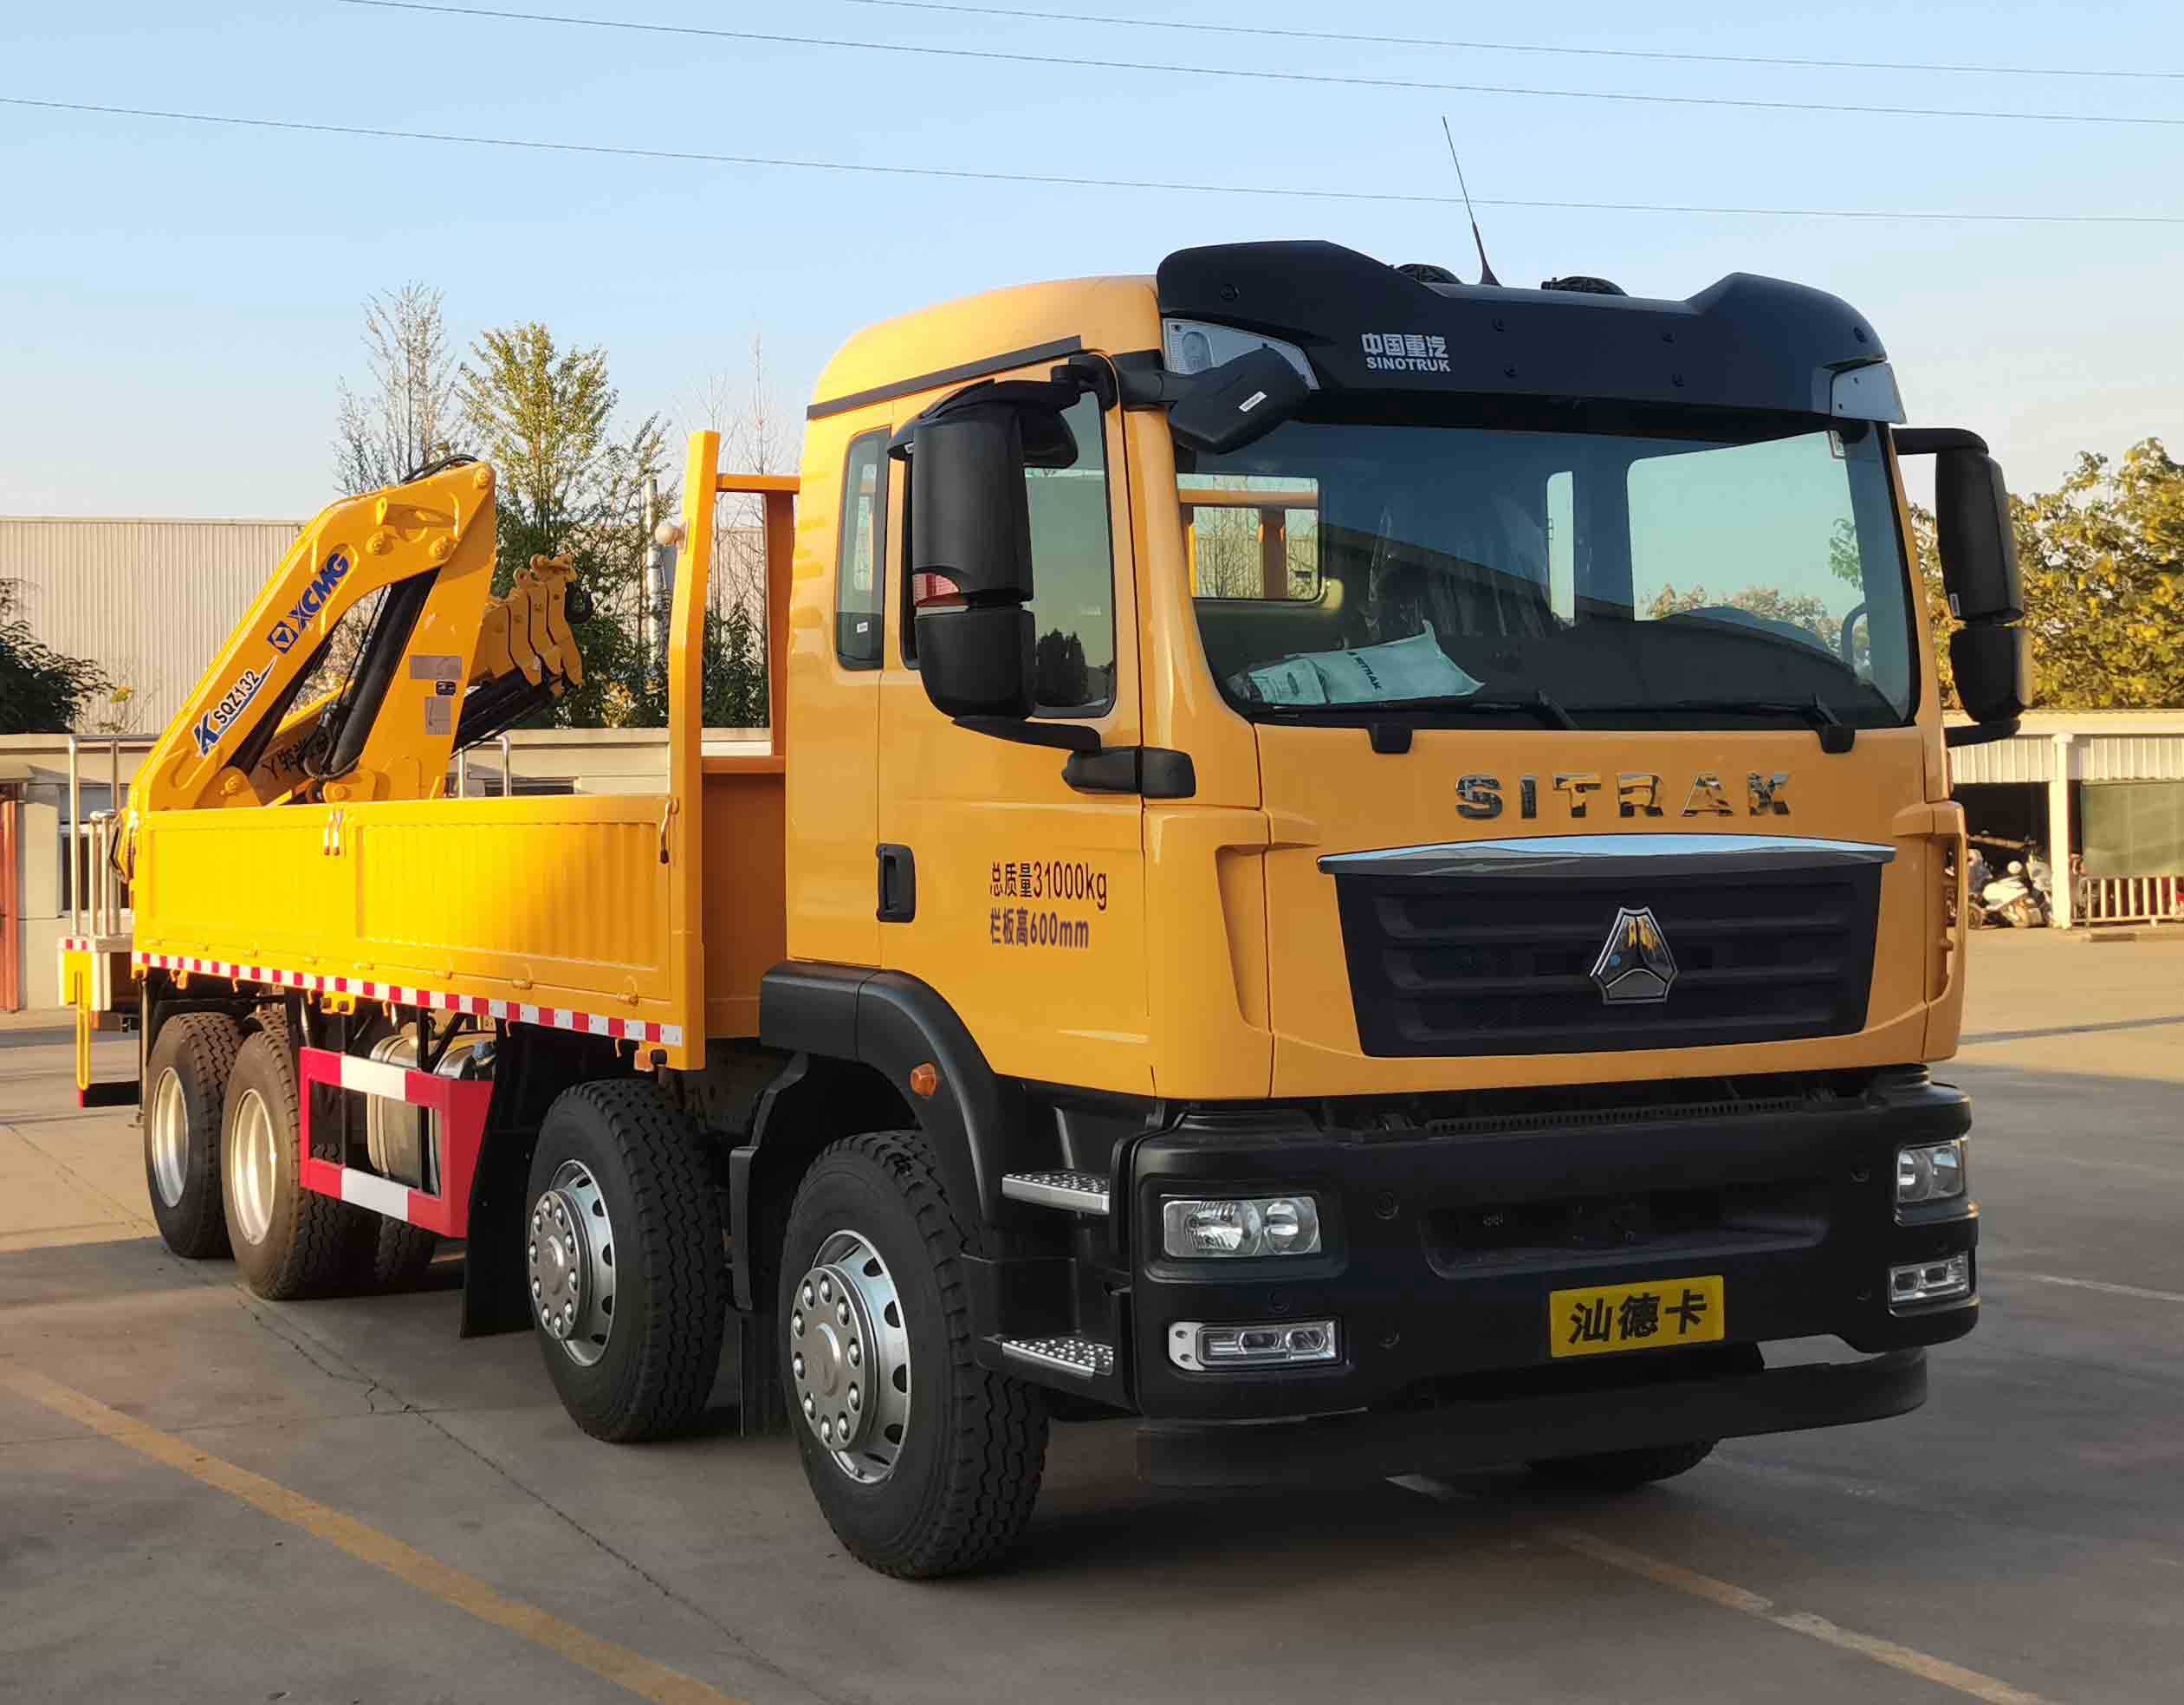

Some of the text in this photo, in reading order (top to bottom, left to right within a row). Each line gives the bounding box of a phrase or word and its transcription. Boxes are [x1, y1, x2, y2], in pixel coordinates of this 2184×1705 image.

[1361, 333, 1449, 358] 中国重汽
[1365, 356, 1451, 373] SINOTRUK
[287, 553, 349, 632] XCMG
[213, 671, 260, 724] SQZ132
[1455, 769, 1792, 820] SITRAK
[989, 860, 1107, 911] 总质量31000kg
[989, 905, 1090, 949] 栏板高600mm
[1567, 1288, 1708, 1345] 汕德卡
